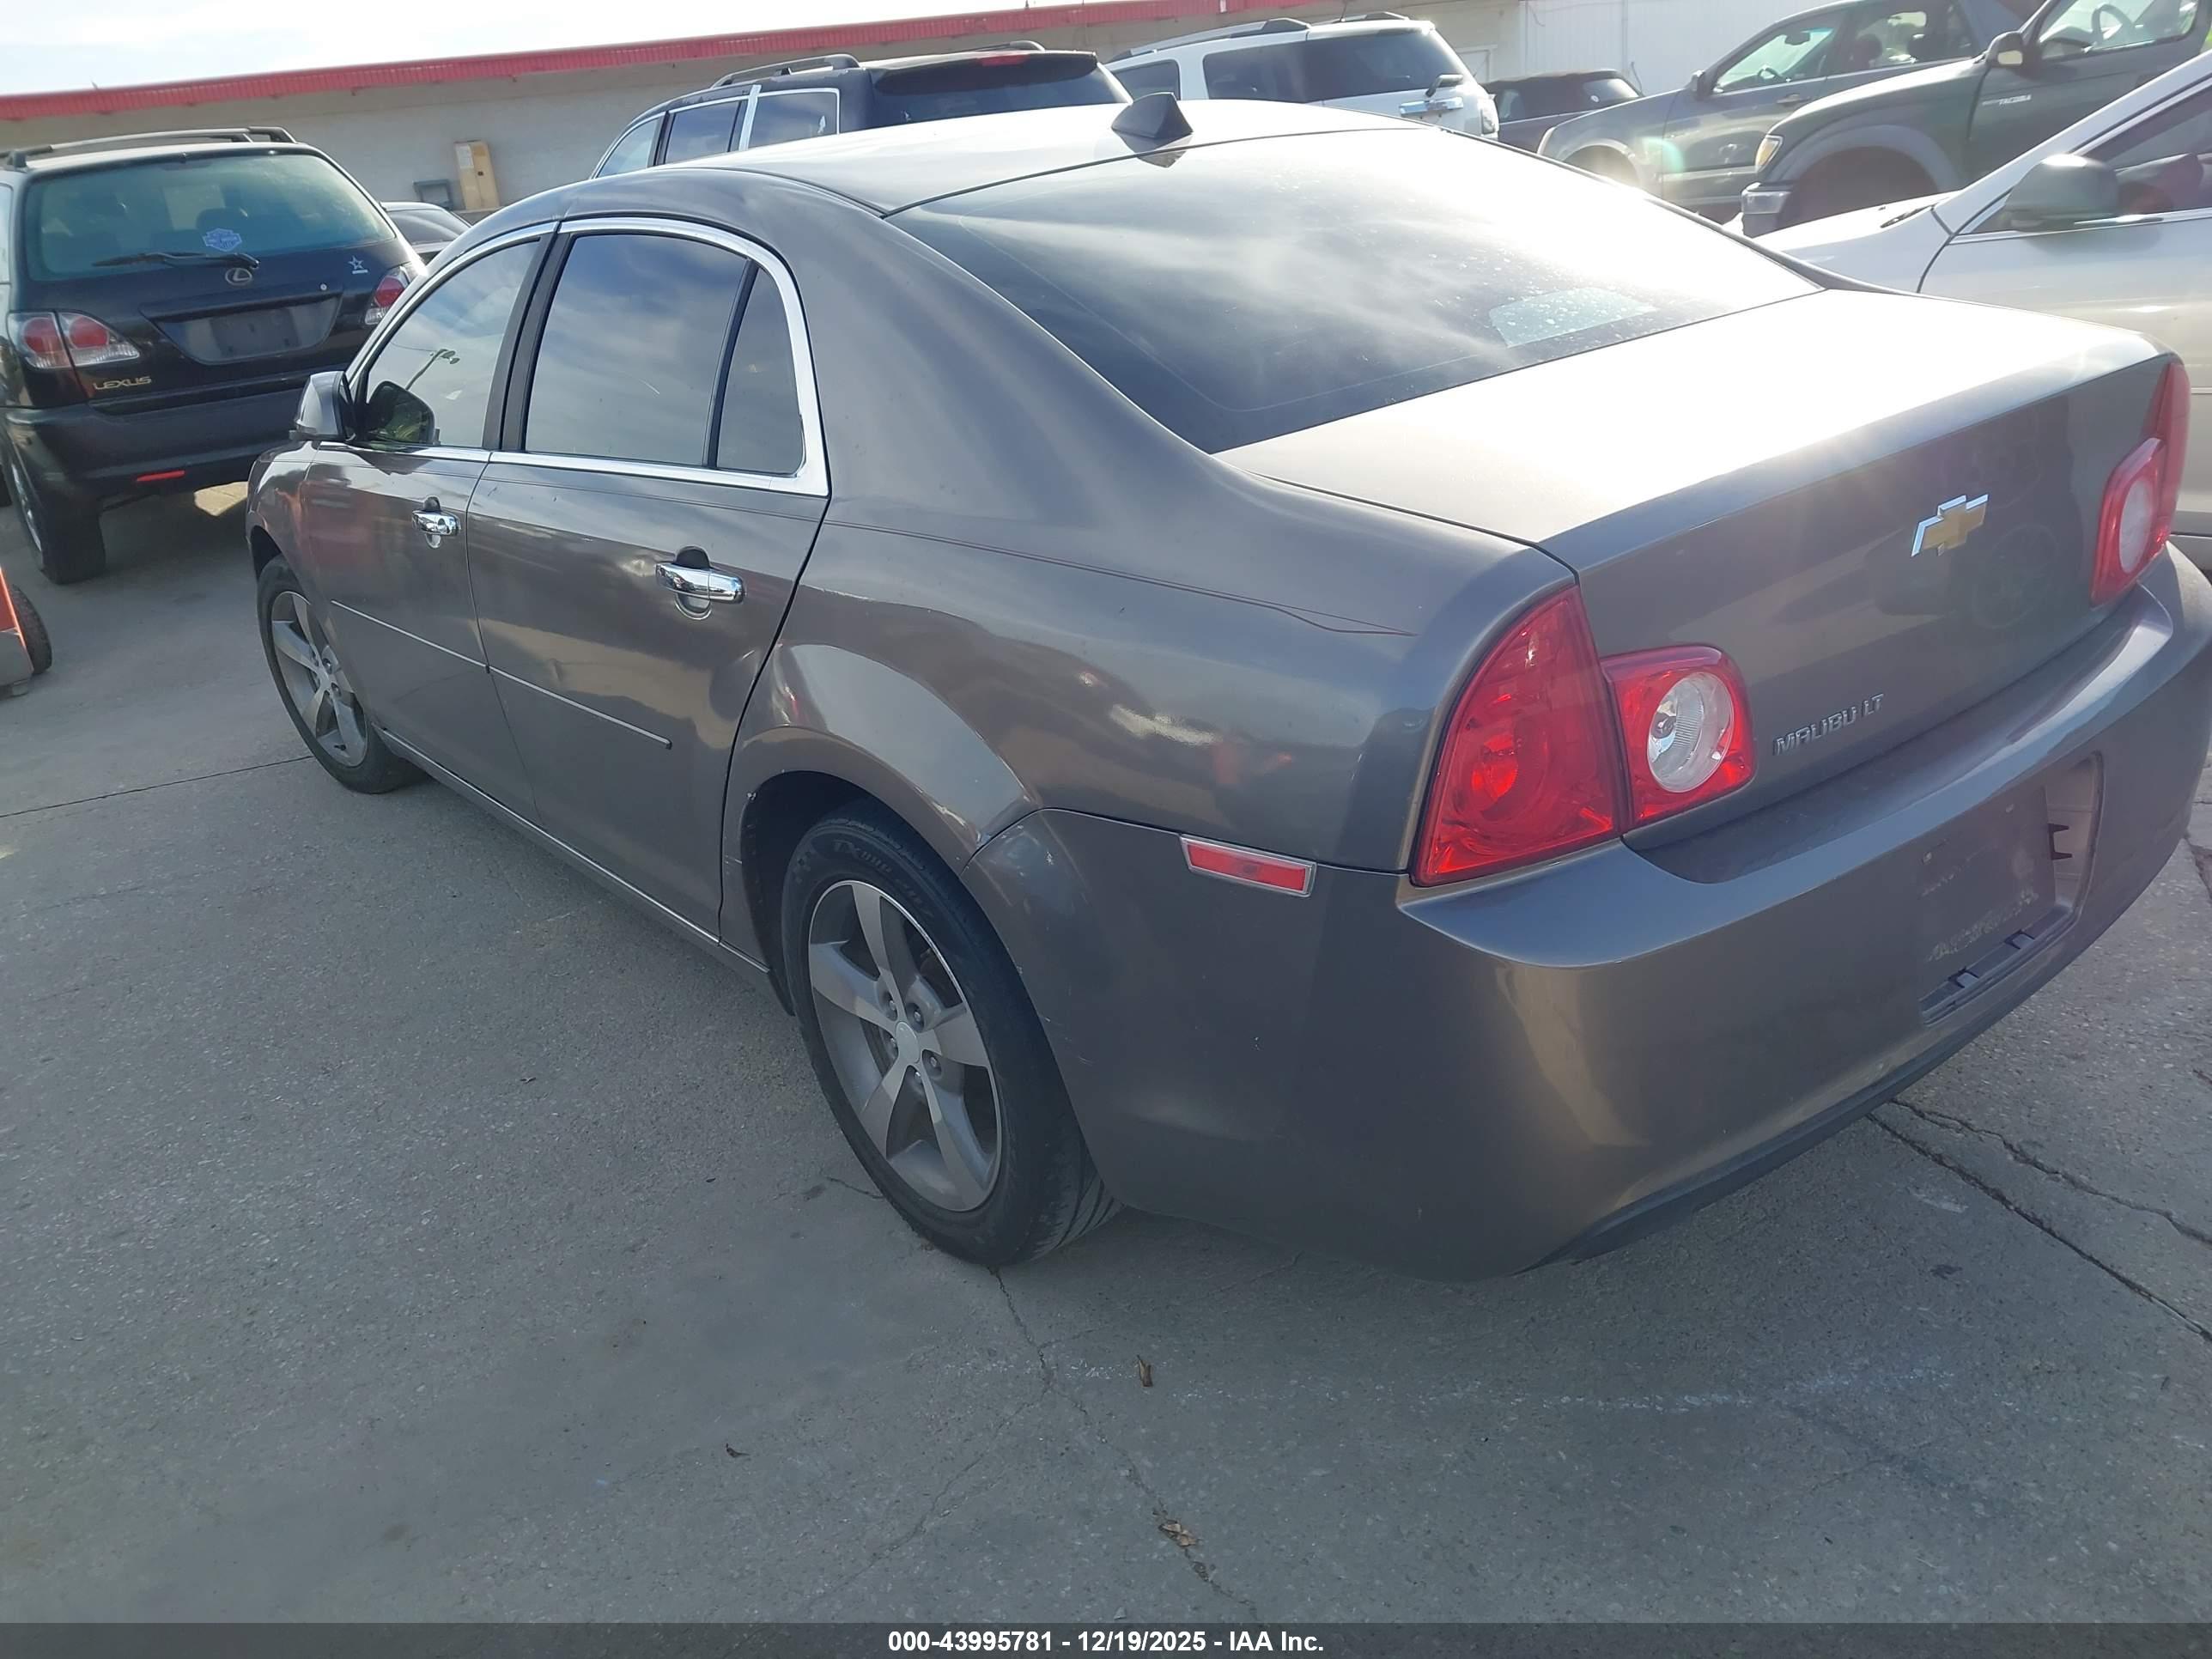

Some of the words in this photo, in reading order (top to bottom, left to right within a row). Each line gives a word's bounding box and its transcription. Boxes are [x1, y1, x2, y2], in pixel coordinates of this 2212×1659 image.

[93, 376, 152, 390] LEXUS
[1773, 706, 1856, 756] MALIBU
[1861, 693, 1884, 717] LT
